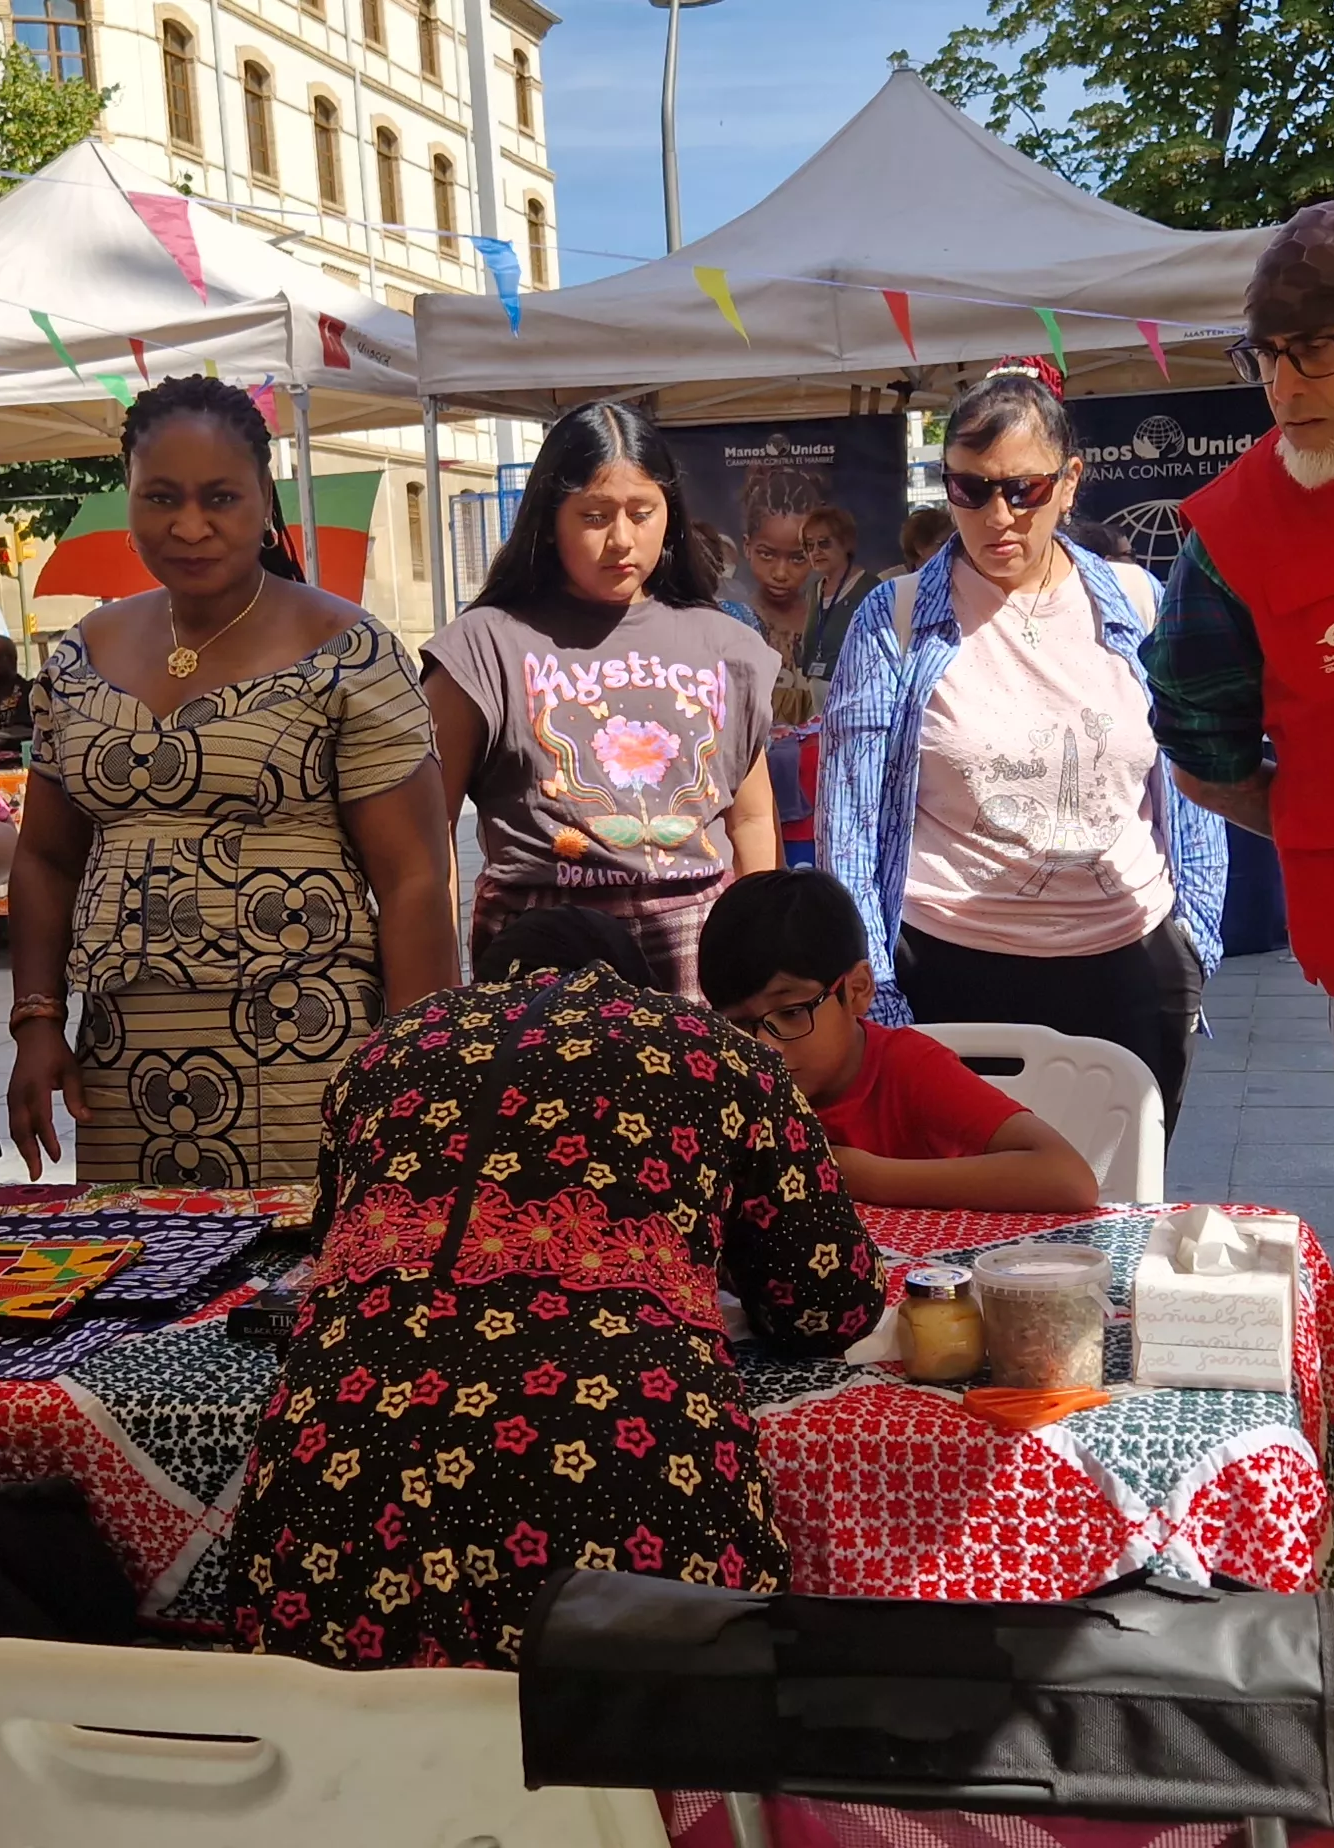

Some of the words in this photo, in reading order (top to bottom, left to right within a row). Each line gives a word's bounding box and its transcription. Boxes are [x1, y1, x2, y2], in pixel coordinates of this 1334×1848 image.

[724, 447, 766, 458] Manos
[791, 444, 836, 455] Unidas
[1128, 463, 1194, 479] CONTRA
[1198, 462, 1214, 475] EL
[524, 651, 727, 731] Mystical
[985, 754, 1049, 783] Paris
[1136, 1308, 1254, 1338] pañuelos
